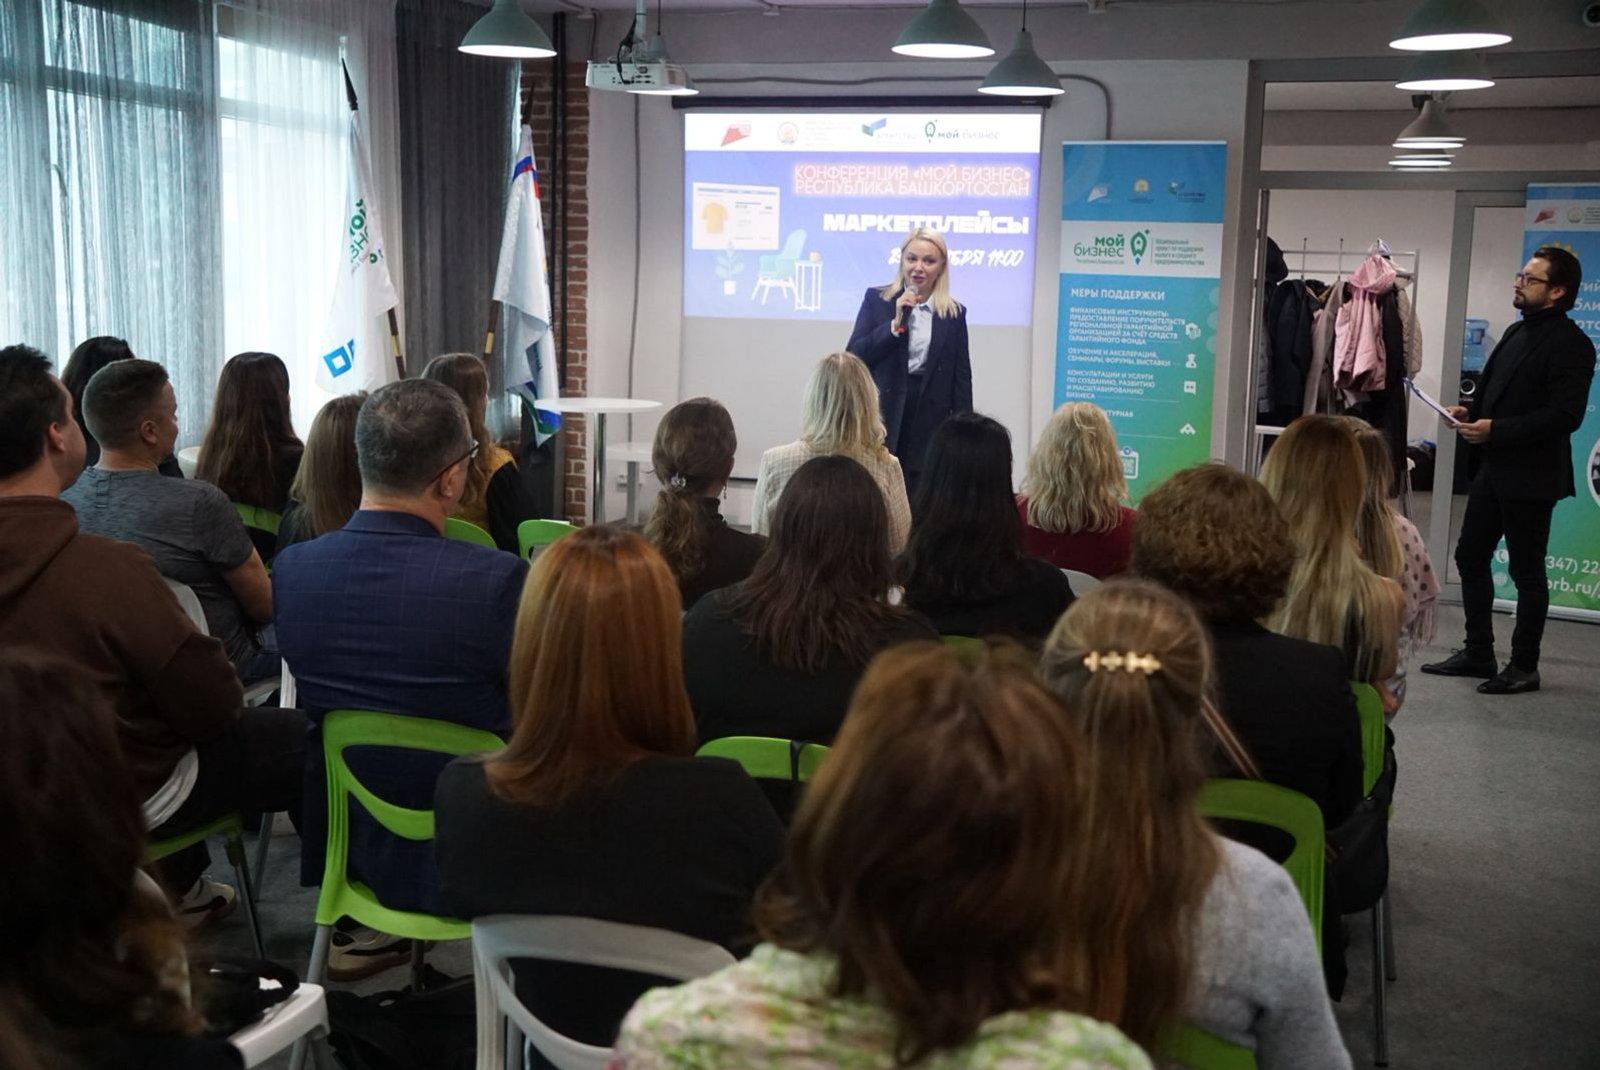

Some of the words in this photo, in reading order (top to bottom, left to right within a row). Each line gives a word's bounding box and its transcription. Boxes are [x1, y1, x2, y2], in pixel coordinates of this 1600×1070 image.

[795, 165, 908, 182] КОНФЕРЕНЦИЯ
[913, 164, 957, 180] «МОЙ
[962, 166, 1030, 181] БИЗНЕС»
[795, 180, 894, 195] РЕСПУБЛИКА
[898, 181, 1030, 196] БАШКОРТОСТАН
[823, 210, 1030, 235] МАРКЕТПЛЕЙСЫ
[1094, 234, 1125, 247] мой
[1073, 242, 1125, 257] бизнес
[1071, 288, 1099, 298] МЕРЫ
[1101, 290, 1166, 301] ПОДДЕРЖКИ
[1573, 298, 1600, 311] бли
[1066, 391, 1096, 399] БИЗНЕСА
